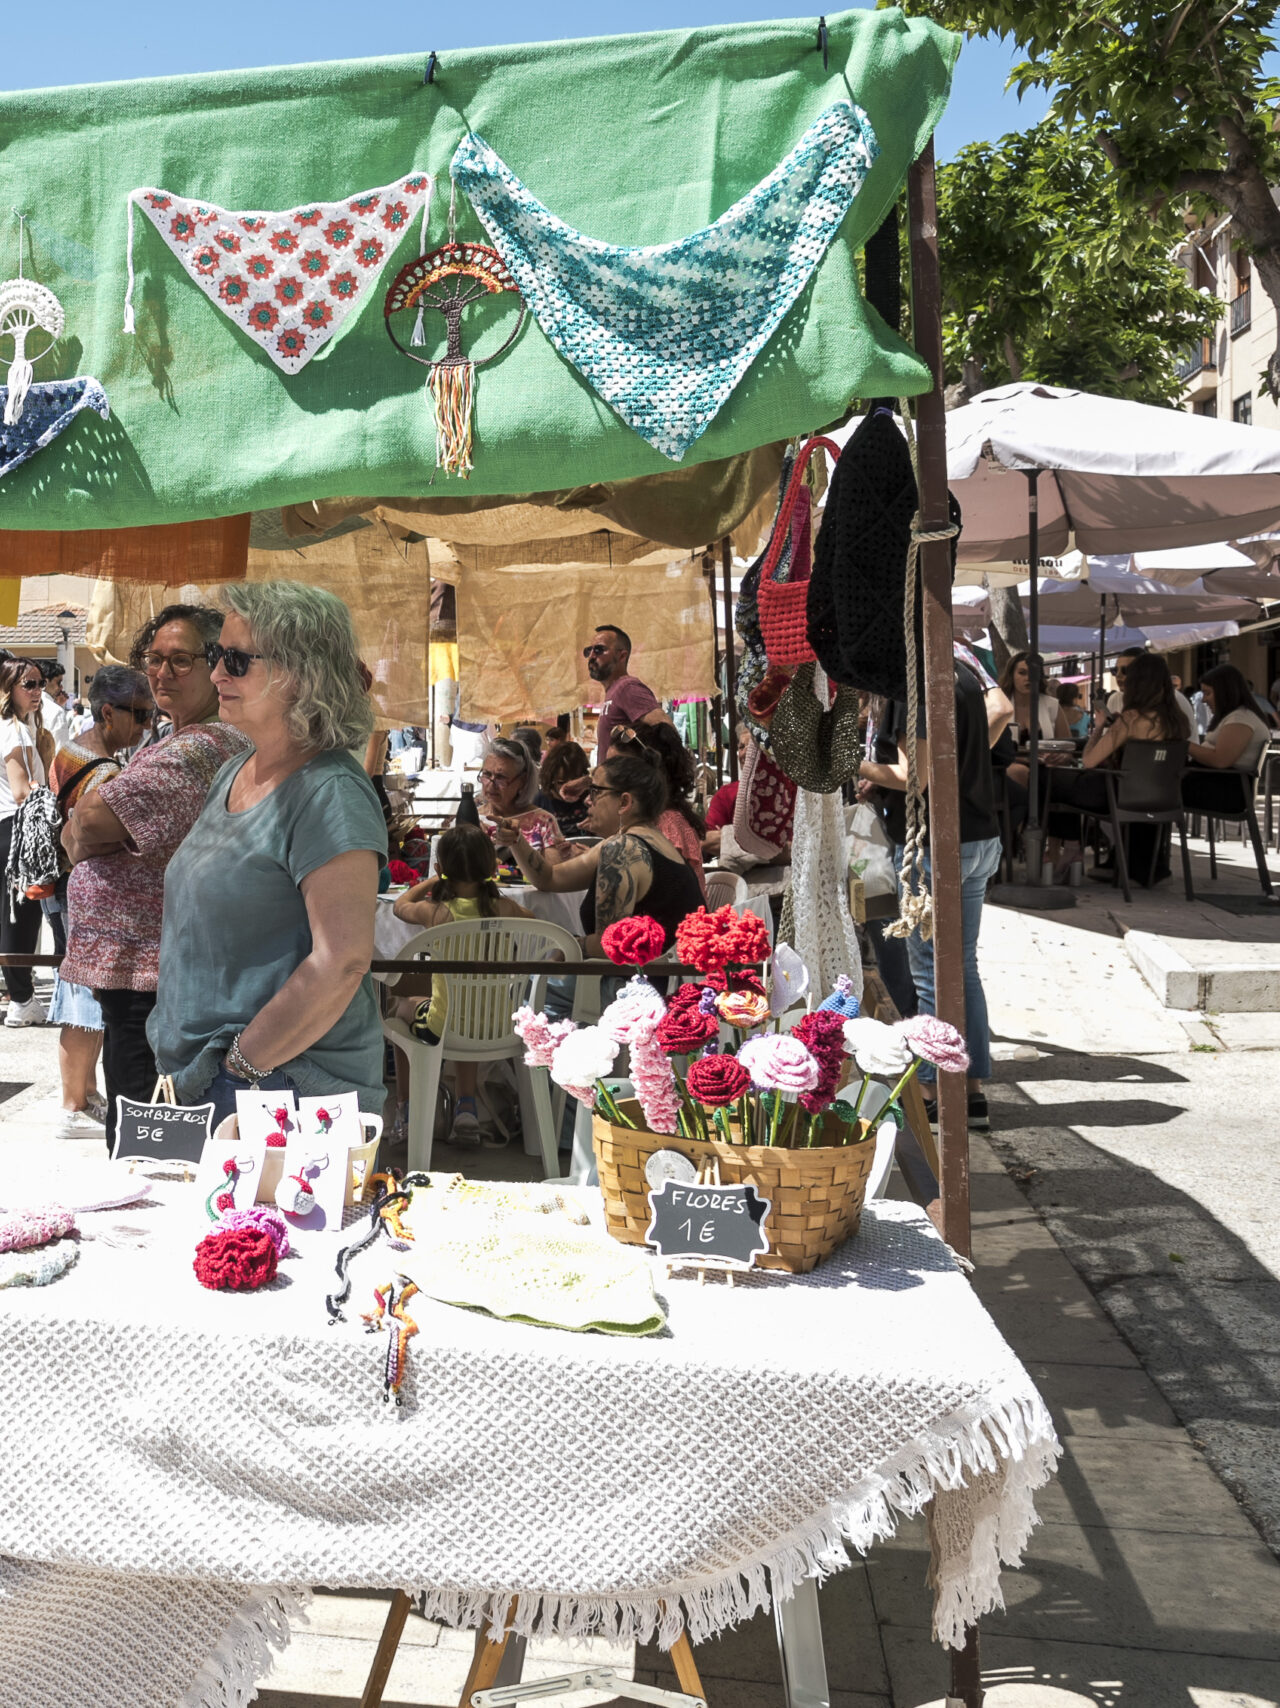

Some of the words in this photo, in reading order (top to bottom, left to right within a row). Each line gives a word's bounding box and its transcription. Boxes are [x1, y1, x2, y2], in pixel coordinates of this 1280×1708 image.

[124, 1107, 207, 1125] SOMBREROS
[136, 1126, 164, 1141] 5€
[672, 1190, 747, 1214] FLORES
